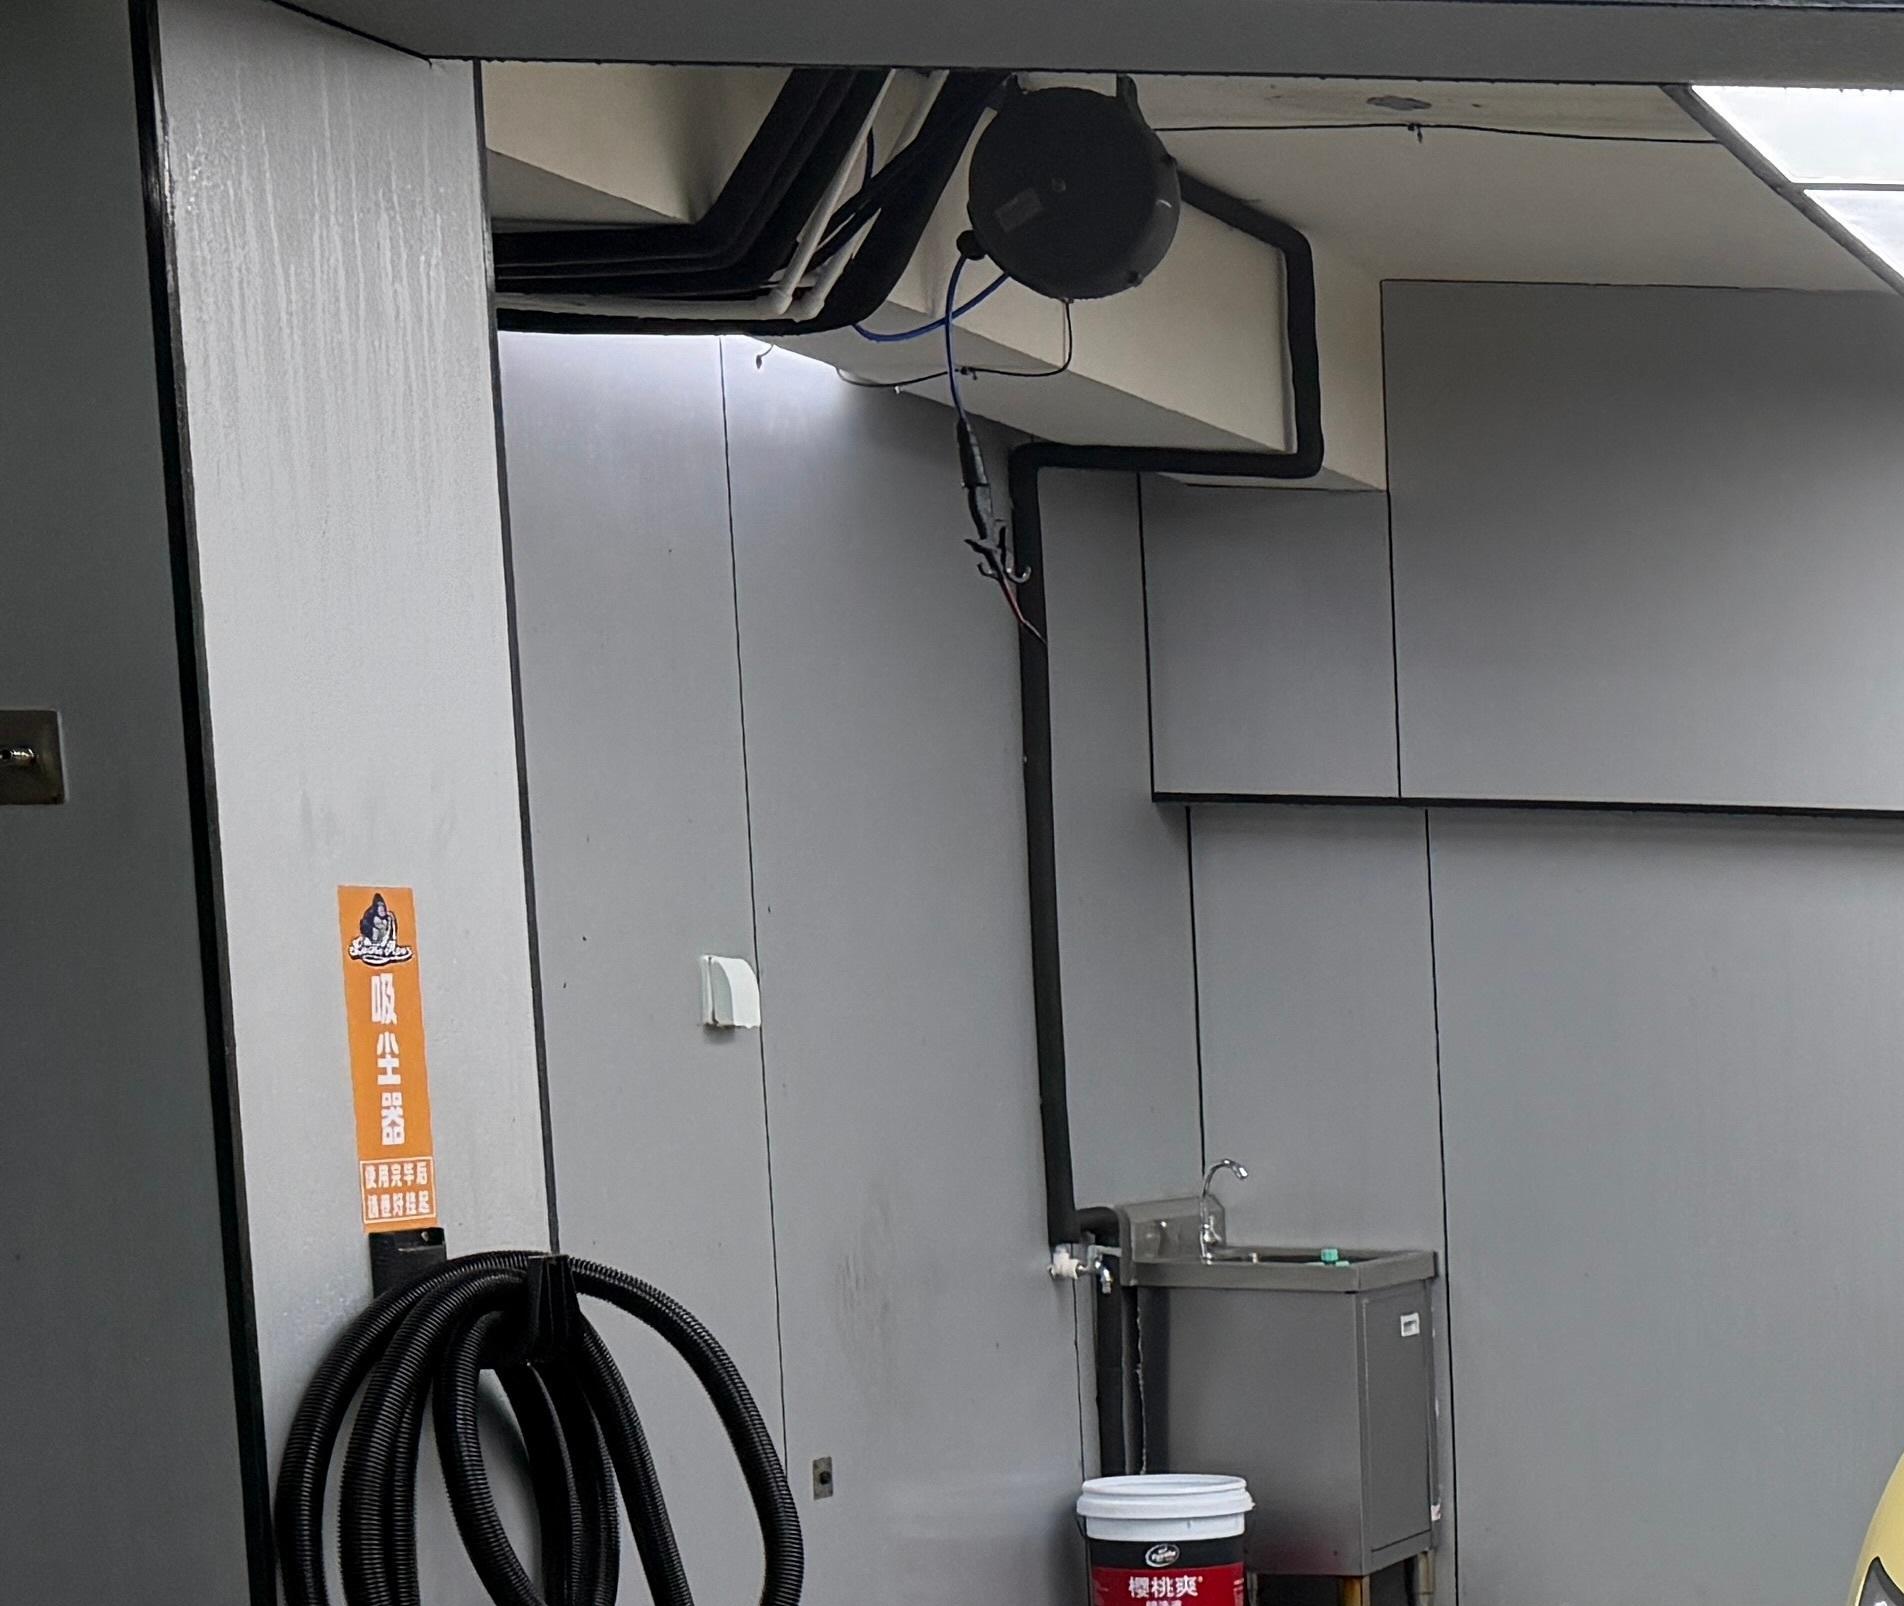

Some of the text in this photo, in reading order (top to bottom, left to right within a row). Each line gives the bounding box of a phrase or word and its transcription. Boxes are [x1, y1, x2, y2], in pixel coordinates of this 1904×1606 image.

[371, 972, 405, 1145] 吸尘器
[365, 1161, 428, 1189] 使用完毕后
